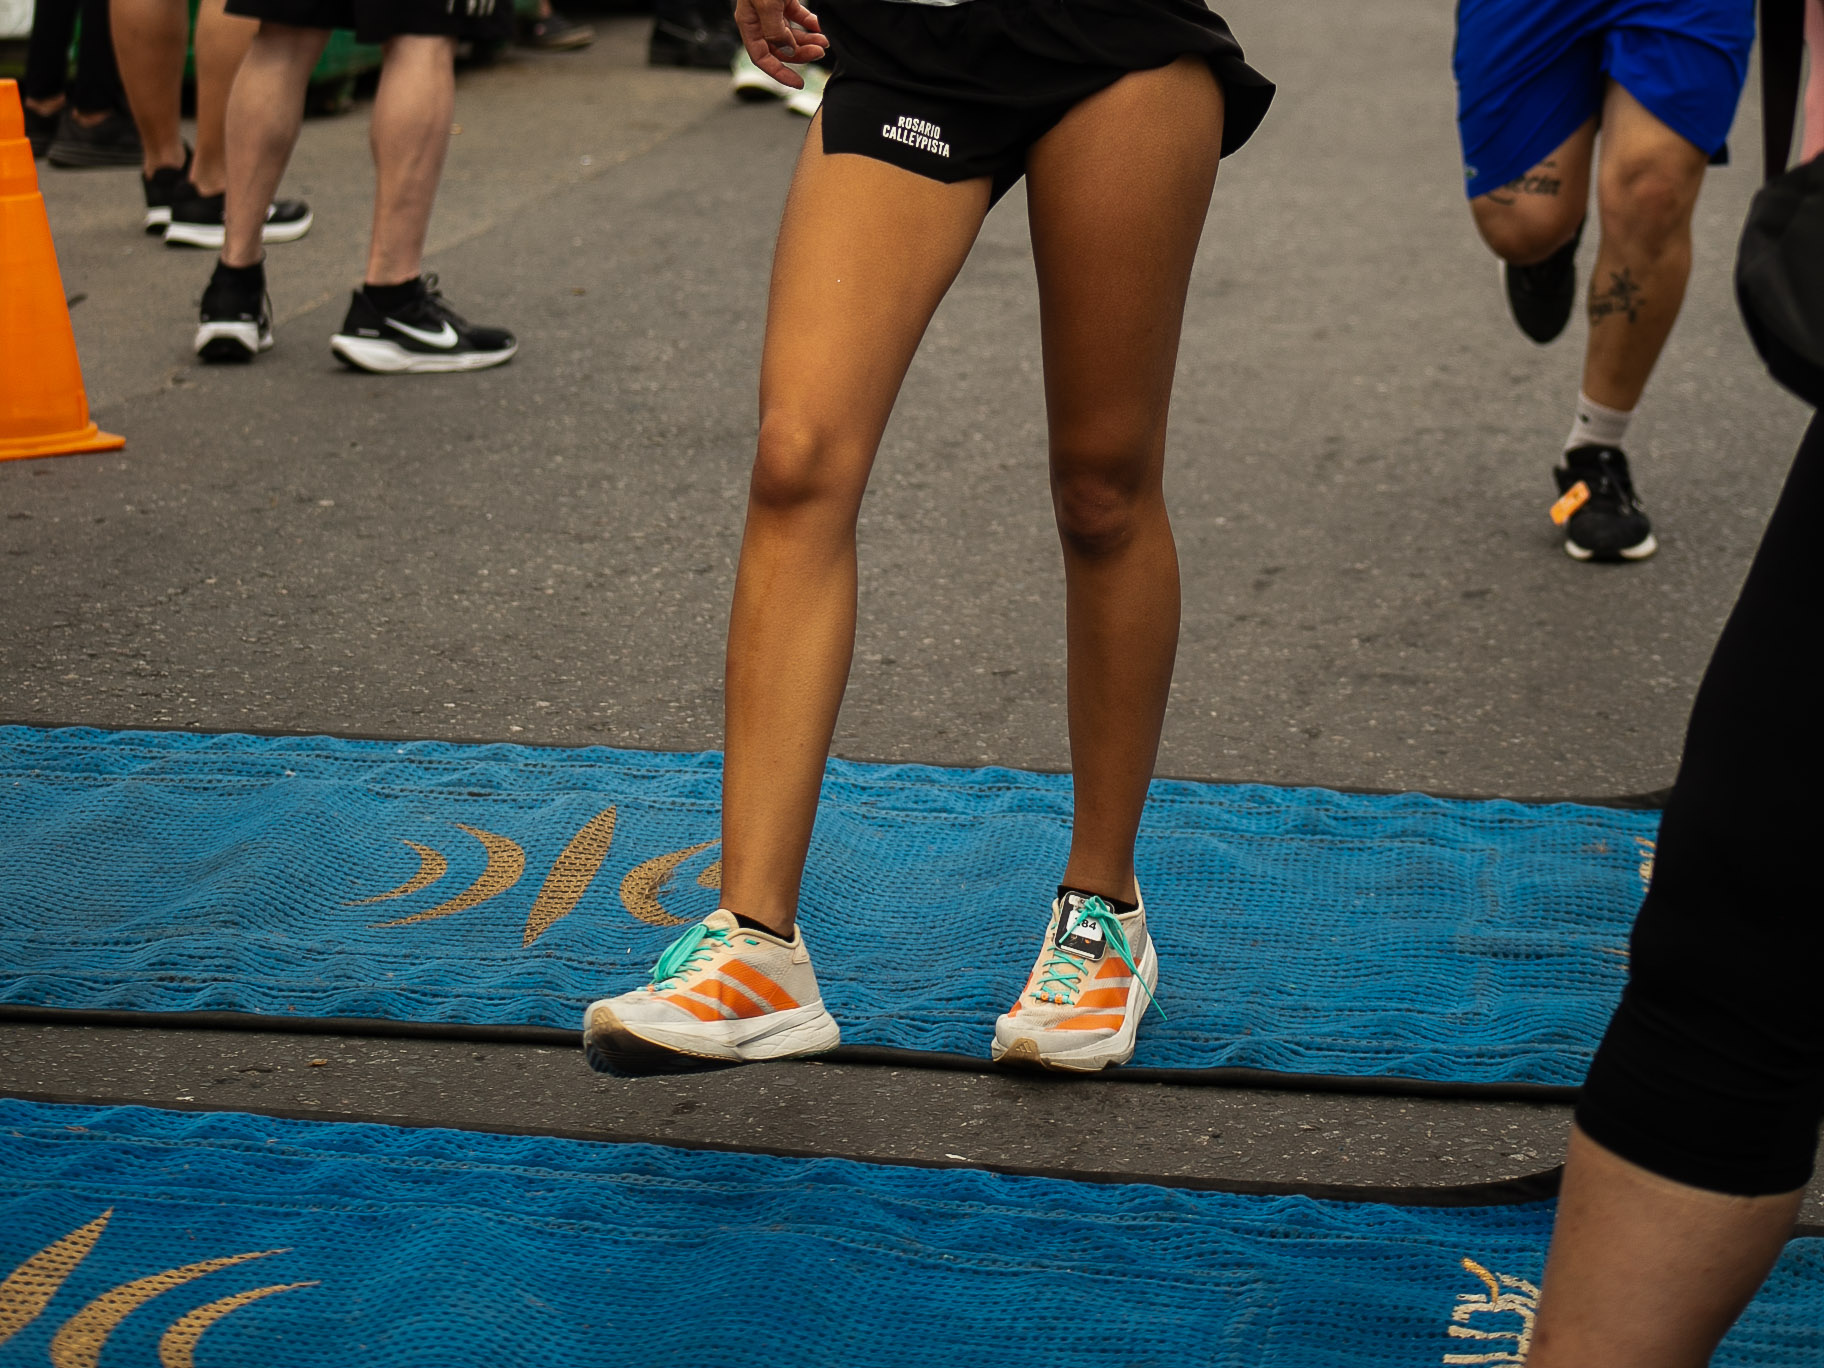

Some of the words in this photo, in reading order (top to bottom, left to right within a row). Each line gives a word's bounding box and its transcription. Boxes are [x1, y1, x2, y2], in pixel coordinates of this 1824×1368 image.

[898, 115, 941, 140] ROSARIO
[882, 124, 950, 158] CALLEYPISTA
[1074, 916, 1097, 930] 84
